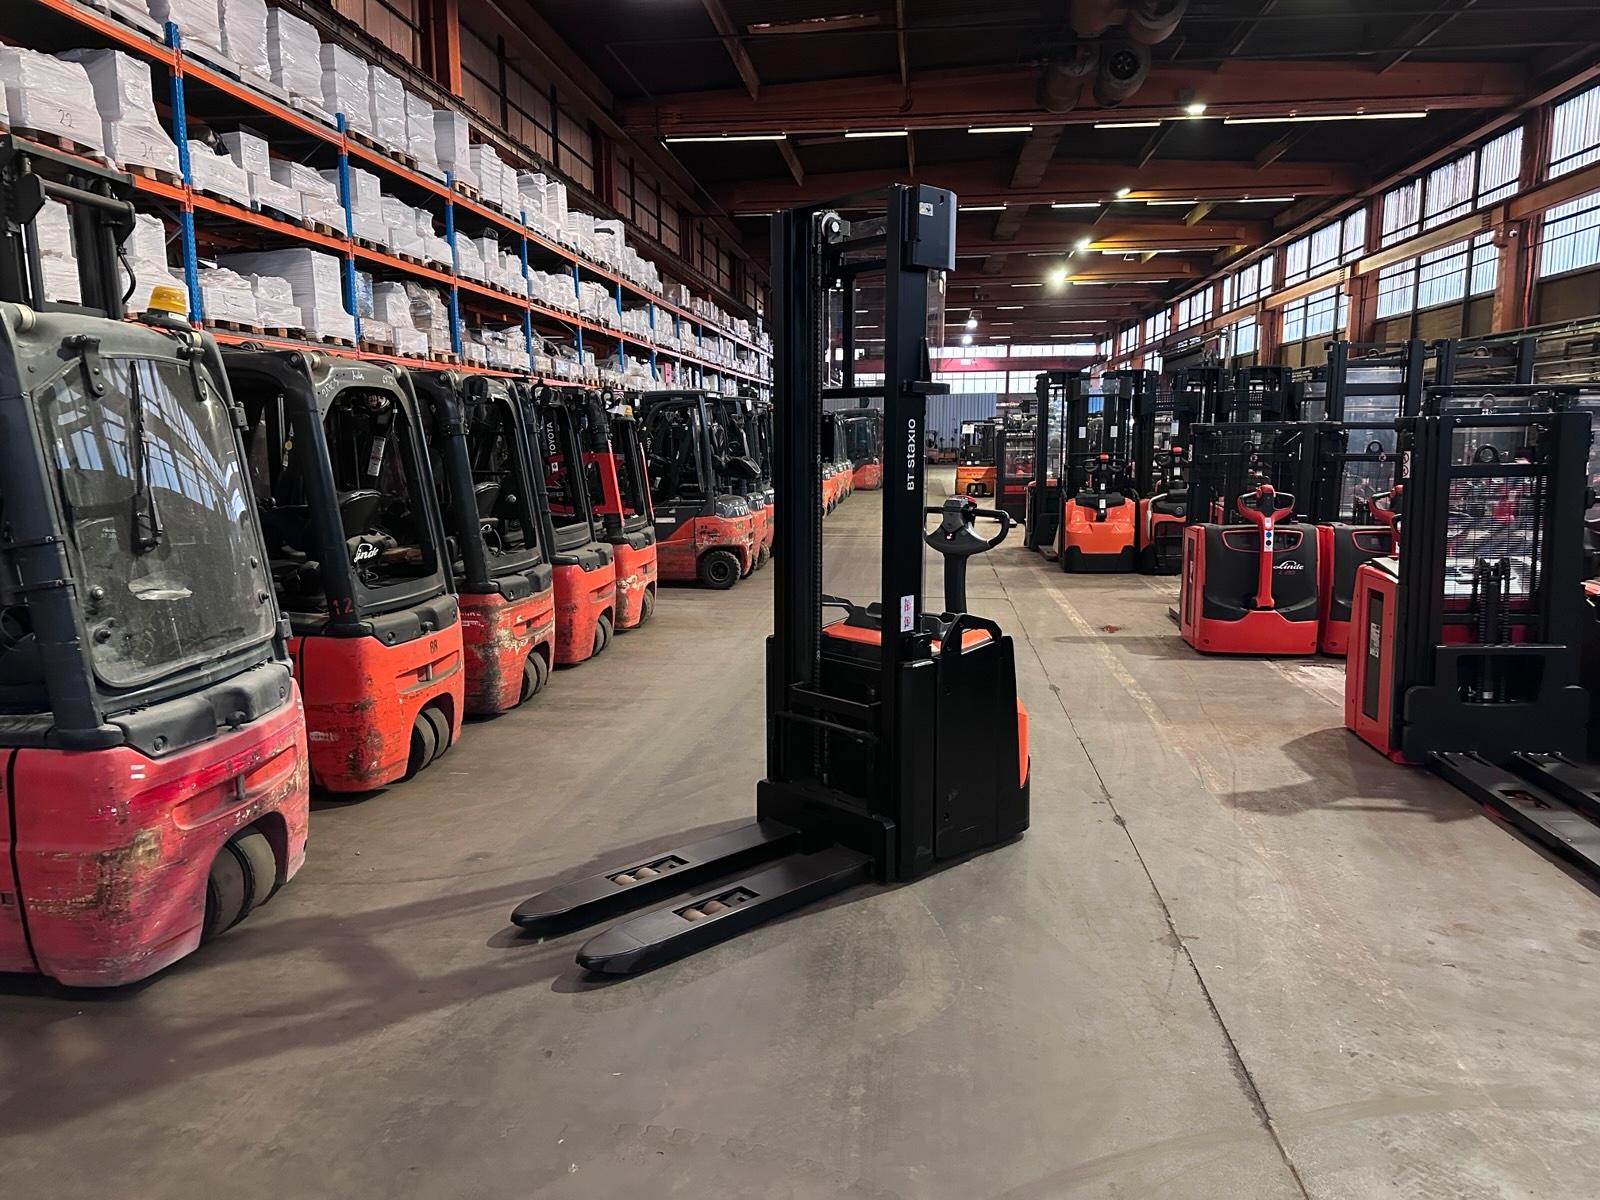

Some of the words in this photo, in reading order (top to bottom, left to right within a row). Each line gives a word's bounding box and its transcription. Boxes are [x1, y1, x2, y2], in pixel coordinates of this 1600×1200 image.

[58, 109, 74, 129] 22
[546, 421, 557, 456] TOYOTA
[907, 473, 915, 491] BT
[1273, 560, 1304, 570] Linde
